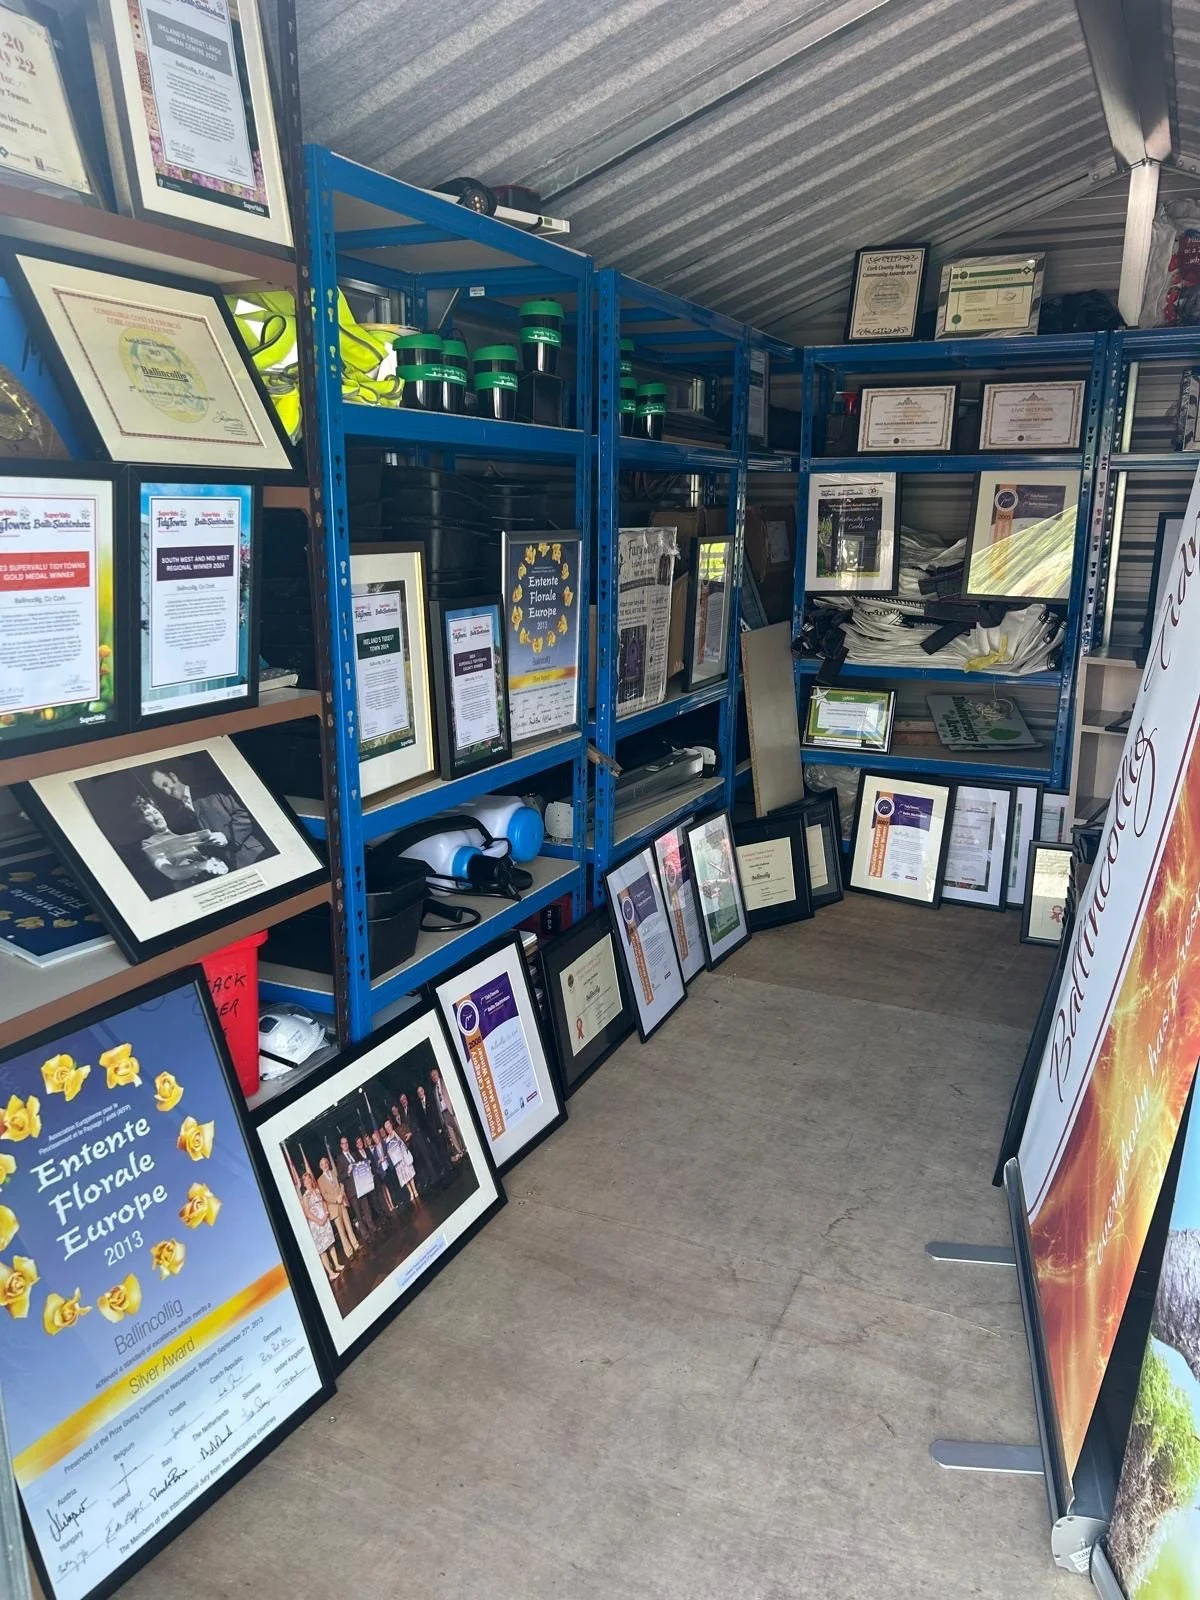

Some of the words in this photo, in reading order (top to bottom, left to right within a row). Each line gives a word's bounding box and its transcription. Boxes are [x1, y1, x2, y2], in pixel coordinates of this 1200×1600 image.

[0, 517, 31, 534] yTowns
[3, 573, 24, 581] GOLD
[25, 572, 48, 580] MEDAL
[49, 571, 75, 580] WINNER
[9, 563, 48, 572] SUPERVALU
[49, 562, 87, 570] TIDYTOWNS
[161, 556, 179, 564] SOUTH
[166, 564, 192, 572] REGIONAL
[528, 576, 559, 588] Entente
[530, 590, 557, 604] Florale
[528, 607, 557, 619] Europe
[1049, 717, 1158, 1103] Ballincollig
[207, 972, 247, 994] ACK
[217, 998, 240, 1018] ER
[477, 1047, 488, 1077] Winner
[1147, 1012, 1170, 1077] has
[470, 1050, 484, 1090] Category
[485, 1077, 494, 1103] Medal
[481, 1091, 497, 1137] Population
[492, 1103, 504, 1133] Bronze
[30, 1117, 151, 1193] Entente
[49, 1152, 155, 1226] Florale
[56, 1182, 168, 1261] Europe
[104, 1230, 145, 1266] 2013
[114, 1300, 184, 1355] Ballincollig
[129, 1362, 160, 1394] Silver
[162, 1336, 195, 1372] Award
[57, 1488, 77, 1507] Austria
[113, 1442, 135, 1461] Belgium
[168, 1401, 187, 1417] Croatia
[209, 1370, 224, 1384] Czech
[223, 1355, 243, 1372] Republic
[263, 1325, 282, 1342] Germany
[64, 1448, 93, 1474] Presented
[93, 1443, 99, 1451] at
[99, 1435, 109, 1446] the
[108, 1425, 122, 1438] Prize
[122, 1412, 140, 1427] Giving
[139, 1393, 164, 1415] Ceremony
[217, 1334, 241, 1355] September
[58, 1531, 84, 1552] Hungary
[112, 1491, 131, 1508] Ireland
[161, 1456, 173, 1468] Italy
[192, 1430, 202, 1441] The
[242, 1382, 261, 1400] Slovenia
[274, 1359, 290, 1374] United
[287, 1346, 306, 1364] Kingdom
[119, 1543, 130, 1554] The
[130, 1522, 155, 1544] Members
[160, 1509, 170, 1519] the
[169, 1482, 199, 1511] International
[199, 1474, 210, 1486] Jury
[210, 1463, 222, 1476] from
[221, 1457, 230, 1466] the
[230, 1432, 257, 1460] participating
